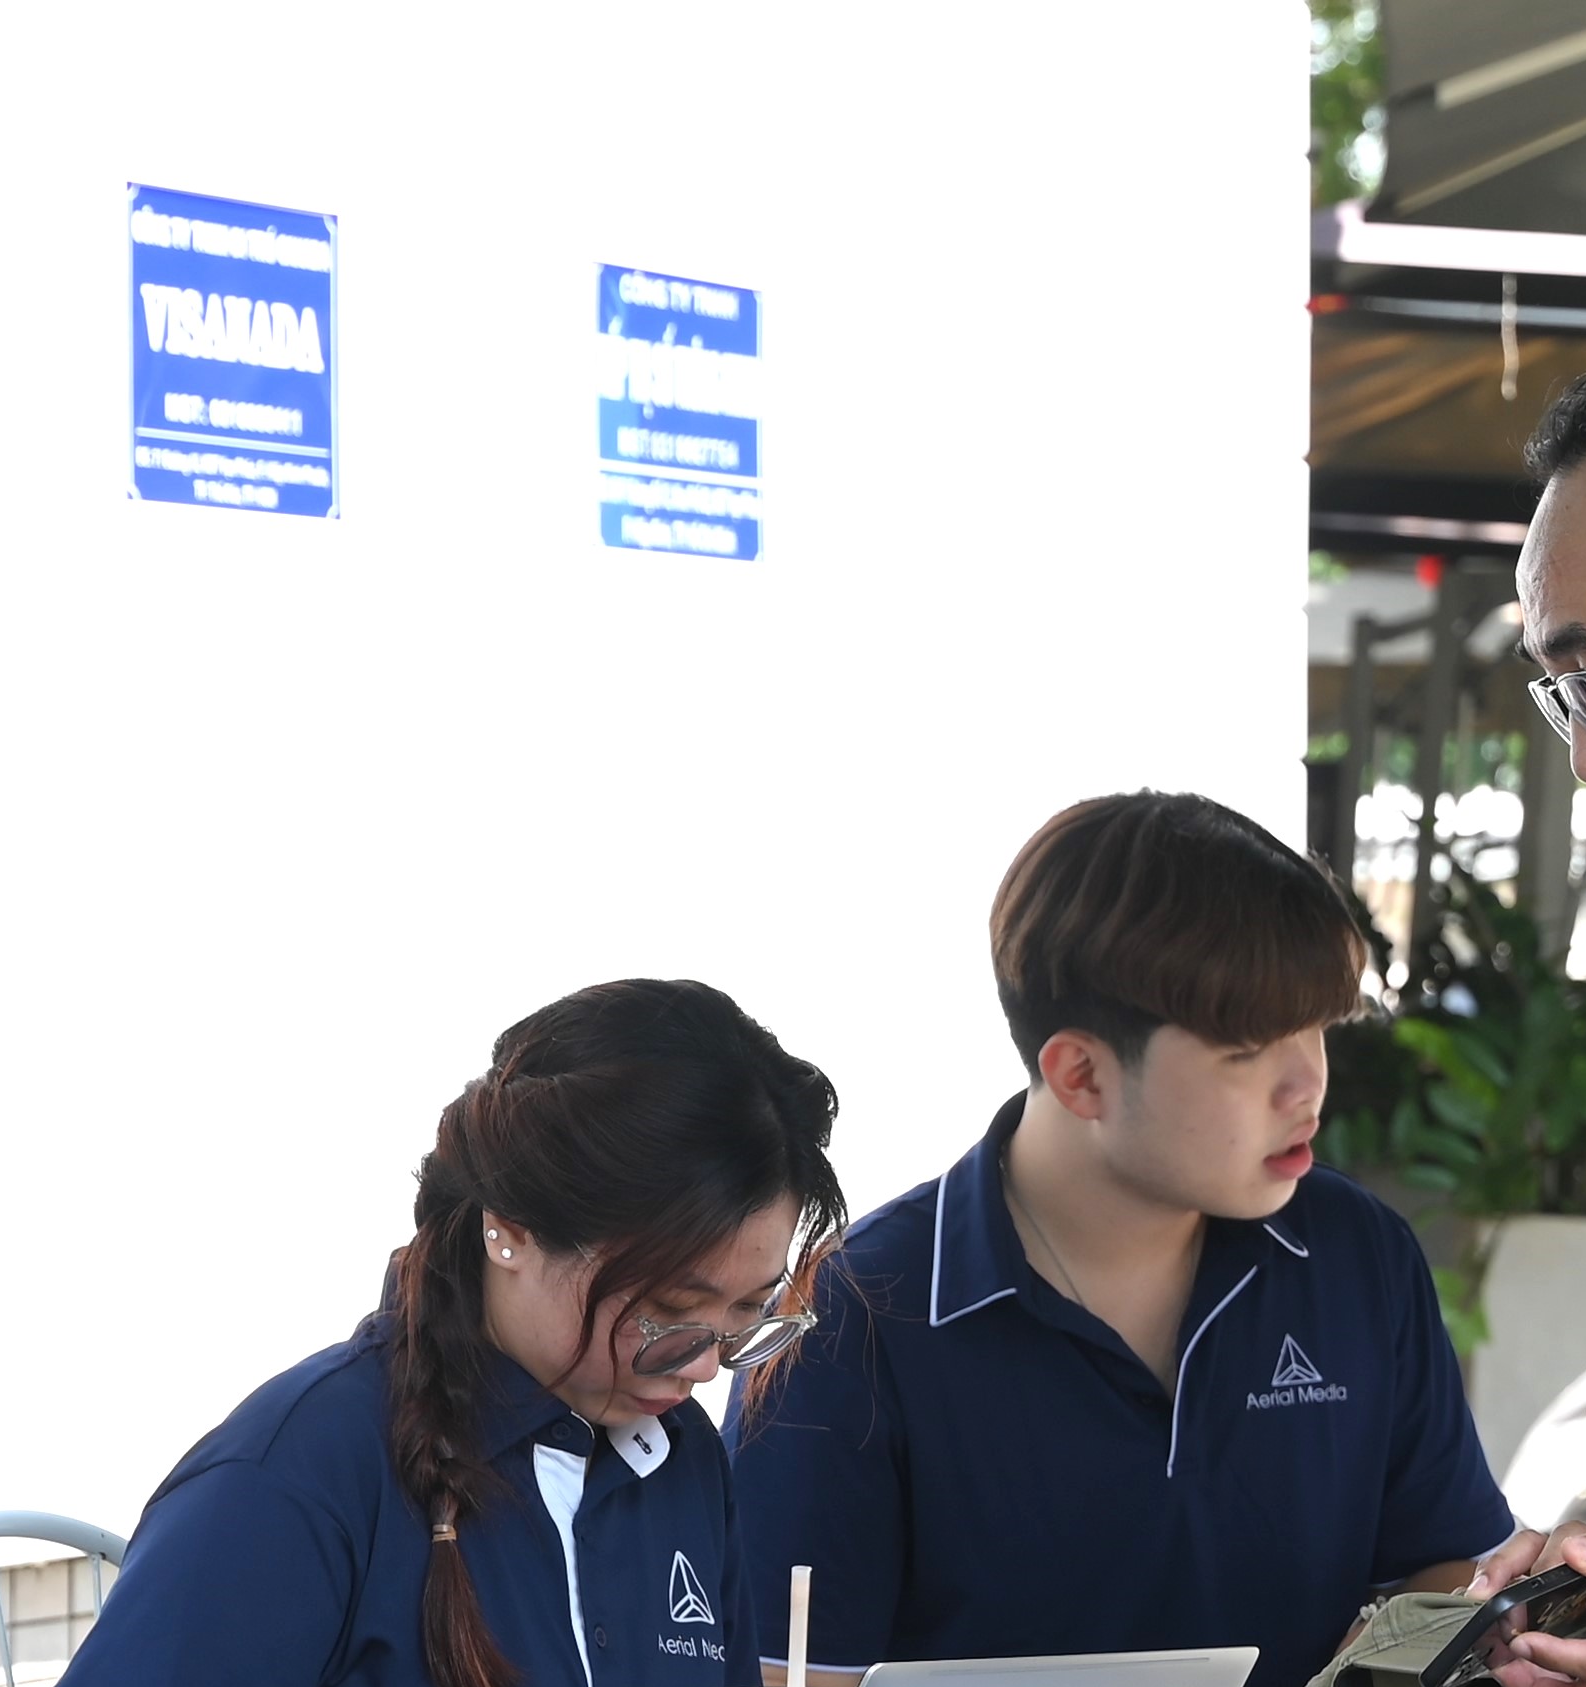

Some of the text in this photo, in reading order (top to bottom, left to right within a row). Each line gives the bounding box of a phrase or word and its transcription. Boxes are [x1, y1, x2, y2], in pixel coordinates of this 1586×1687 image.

[1246, 1383, 1348, 1410] Aerial Media
[658, 1633, 698, 1657] Aerial
